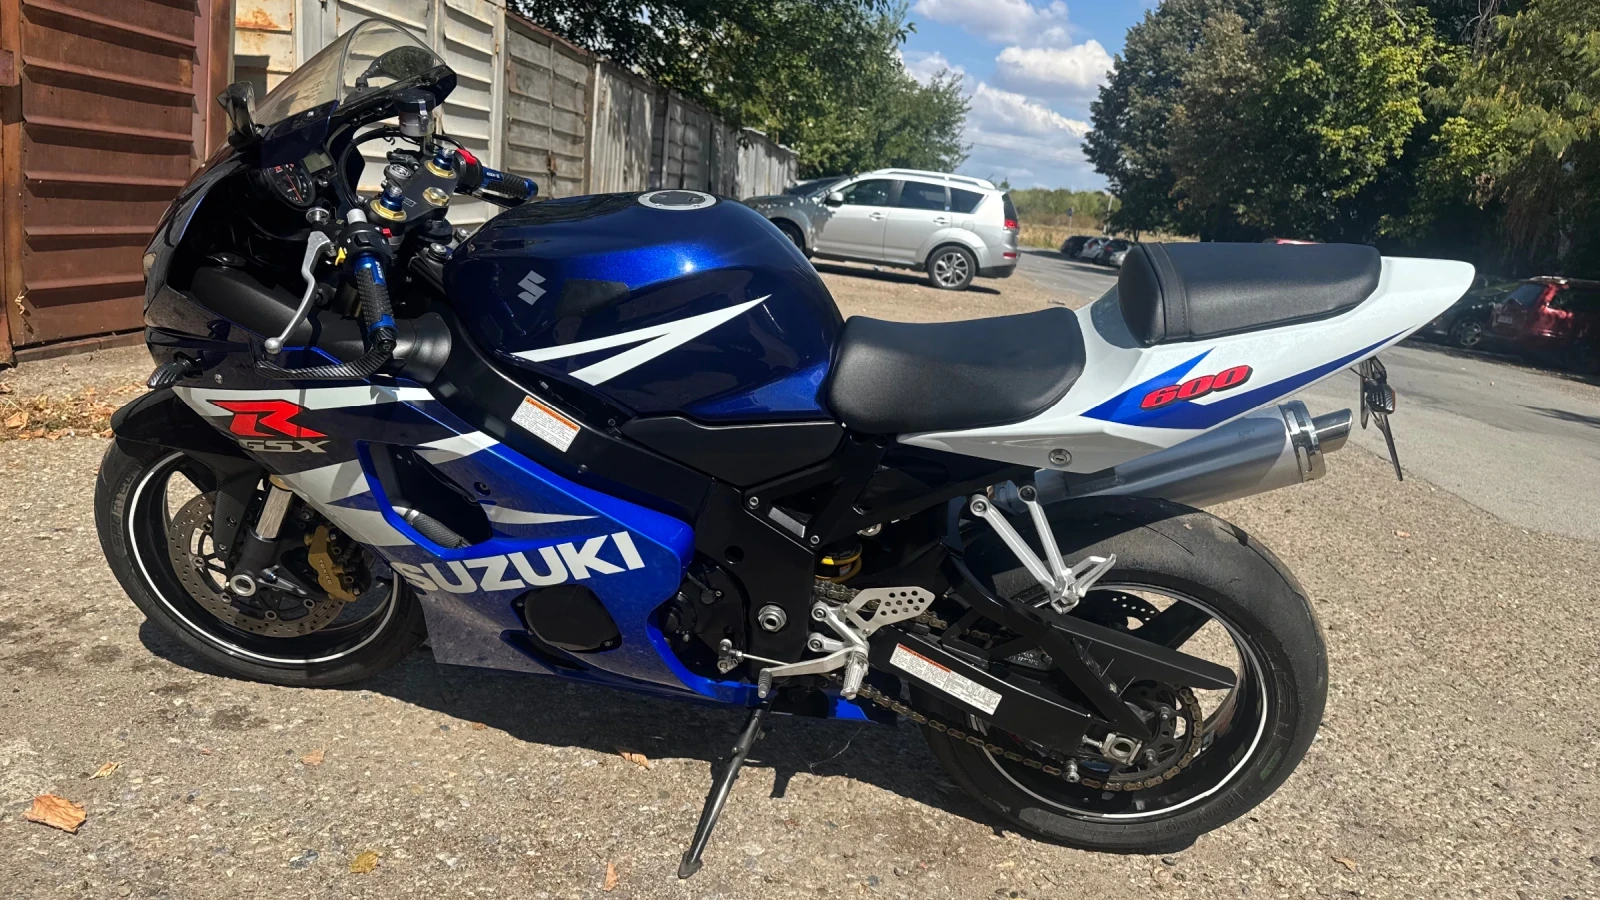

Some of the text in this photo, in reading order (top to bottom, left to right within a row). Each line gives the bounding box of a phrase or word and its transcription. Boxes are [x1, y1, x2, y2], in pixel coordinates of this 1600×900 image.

[1140, 365, 1253, 411] 600
[206, 399, 328, 438] R
[238, 439, 331, 453] GSX
[390, 531, 645, 594] SUZUKI
